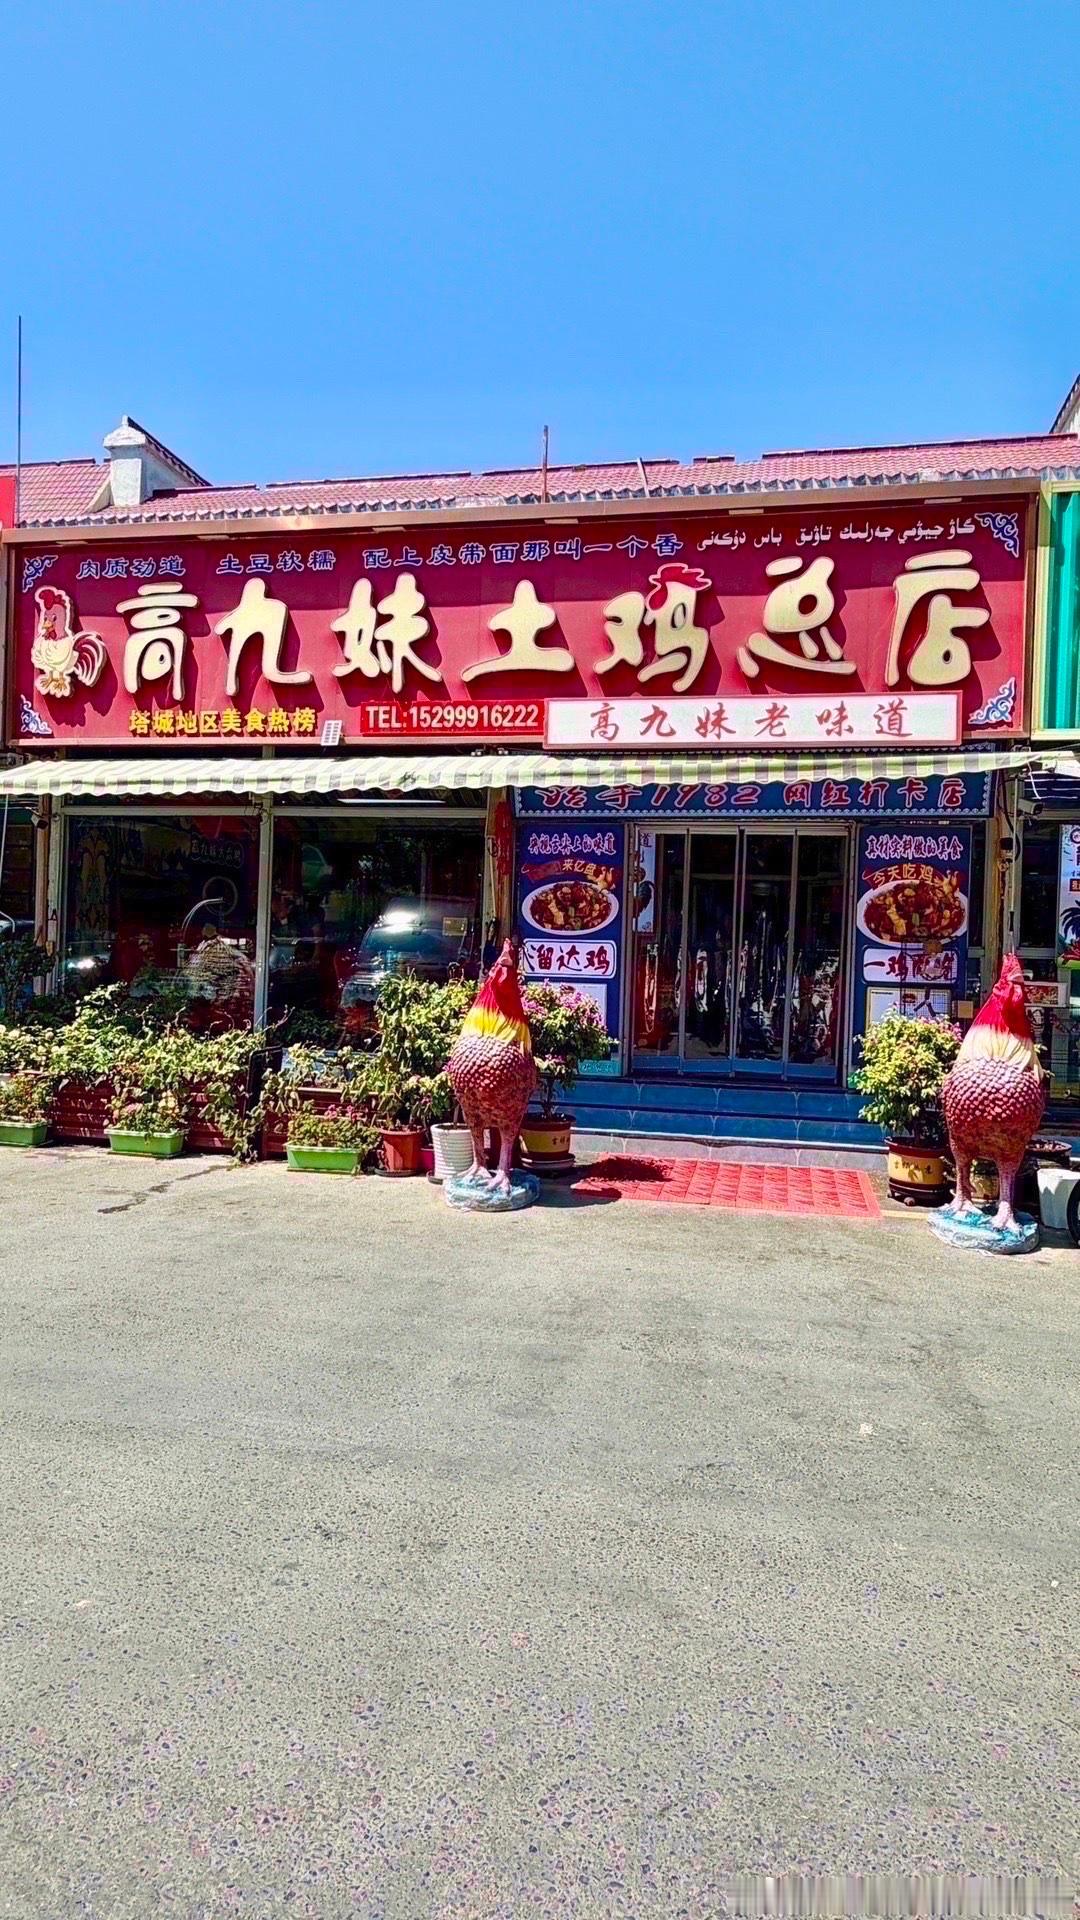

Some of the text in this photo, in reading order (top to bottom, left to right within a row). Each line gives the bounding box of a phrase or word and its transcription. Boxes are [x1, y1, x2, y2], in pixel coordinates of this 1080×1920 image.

[75, 533, 684, 580] 肉质劲道 土豆软糯 配上皮带面那叫一个香
[115, 549, 990, 701] 高九妹土鸡总店
[128, 707, 317, 736] 塔城地区美食热榜
[366, 704, 539, 729] TEL:15299916222
[589, 697, 914, 742] 高九妹老味道
[783, 777, 966, 809] 网红打卡店
[873, 863, 935, 886] 今天吃鸡
